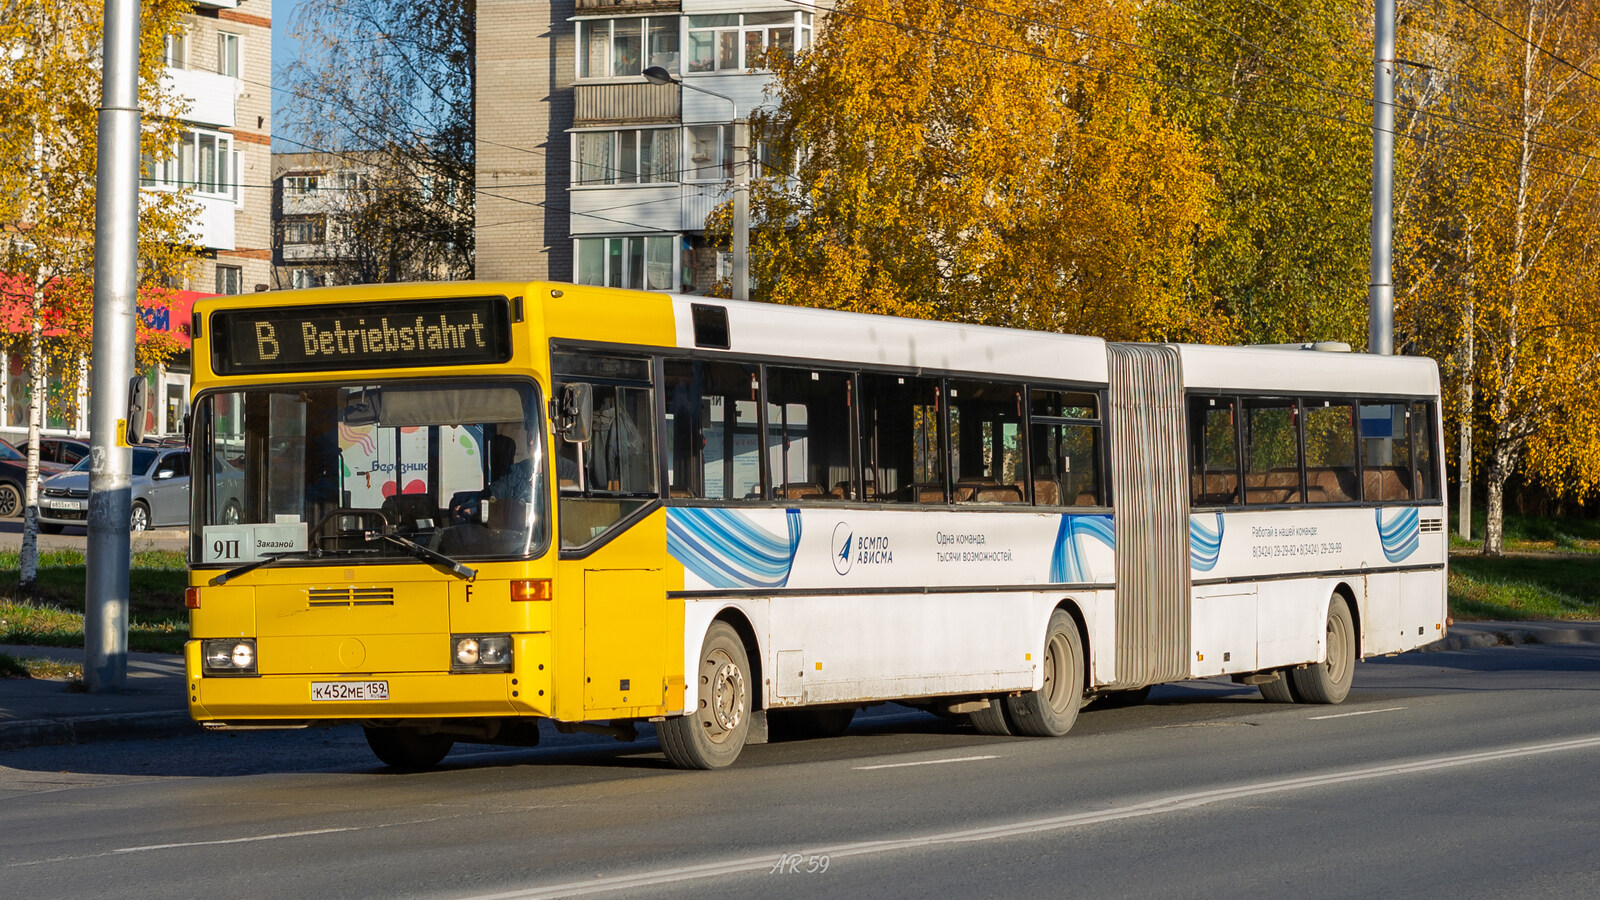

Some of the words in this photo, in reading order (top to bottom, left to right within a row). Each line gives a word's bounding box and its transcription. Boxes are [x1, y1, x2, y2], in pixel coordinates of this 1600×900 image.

[255, 321, 280, 360] B
[301, 313, 486, 356] Betriebsfahrt
[371, 460, 428, 475] Берзник
[936, 531, 955, 546] Одна
[955, 534, 987, 547] команда,
[1252, 526, 1273, 538] Работай
[1279, 526, 1296, 537] нашей
[213, 540, 240, 559] 9П
[256, 540, 294, 548] Заказной
[858, 536, 889, 550] ВСМПО
[856, 551, 893, 564] АВИСМА
[936, 551, 961, 562] тысячи
[962, 548, 1014, 562] возможностей.
[466, 584, 473, 603] F
[316, 684, 363, 699] К452МЕ
[366, 682, 385, 694] 159
